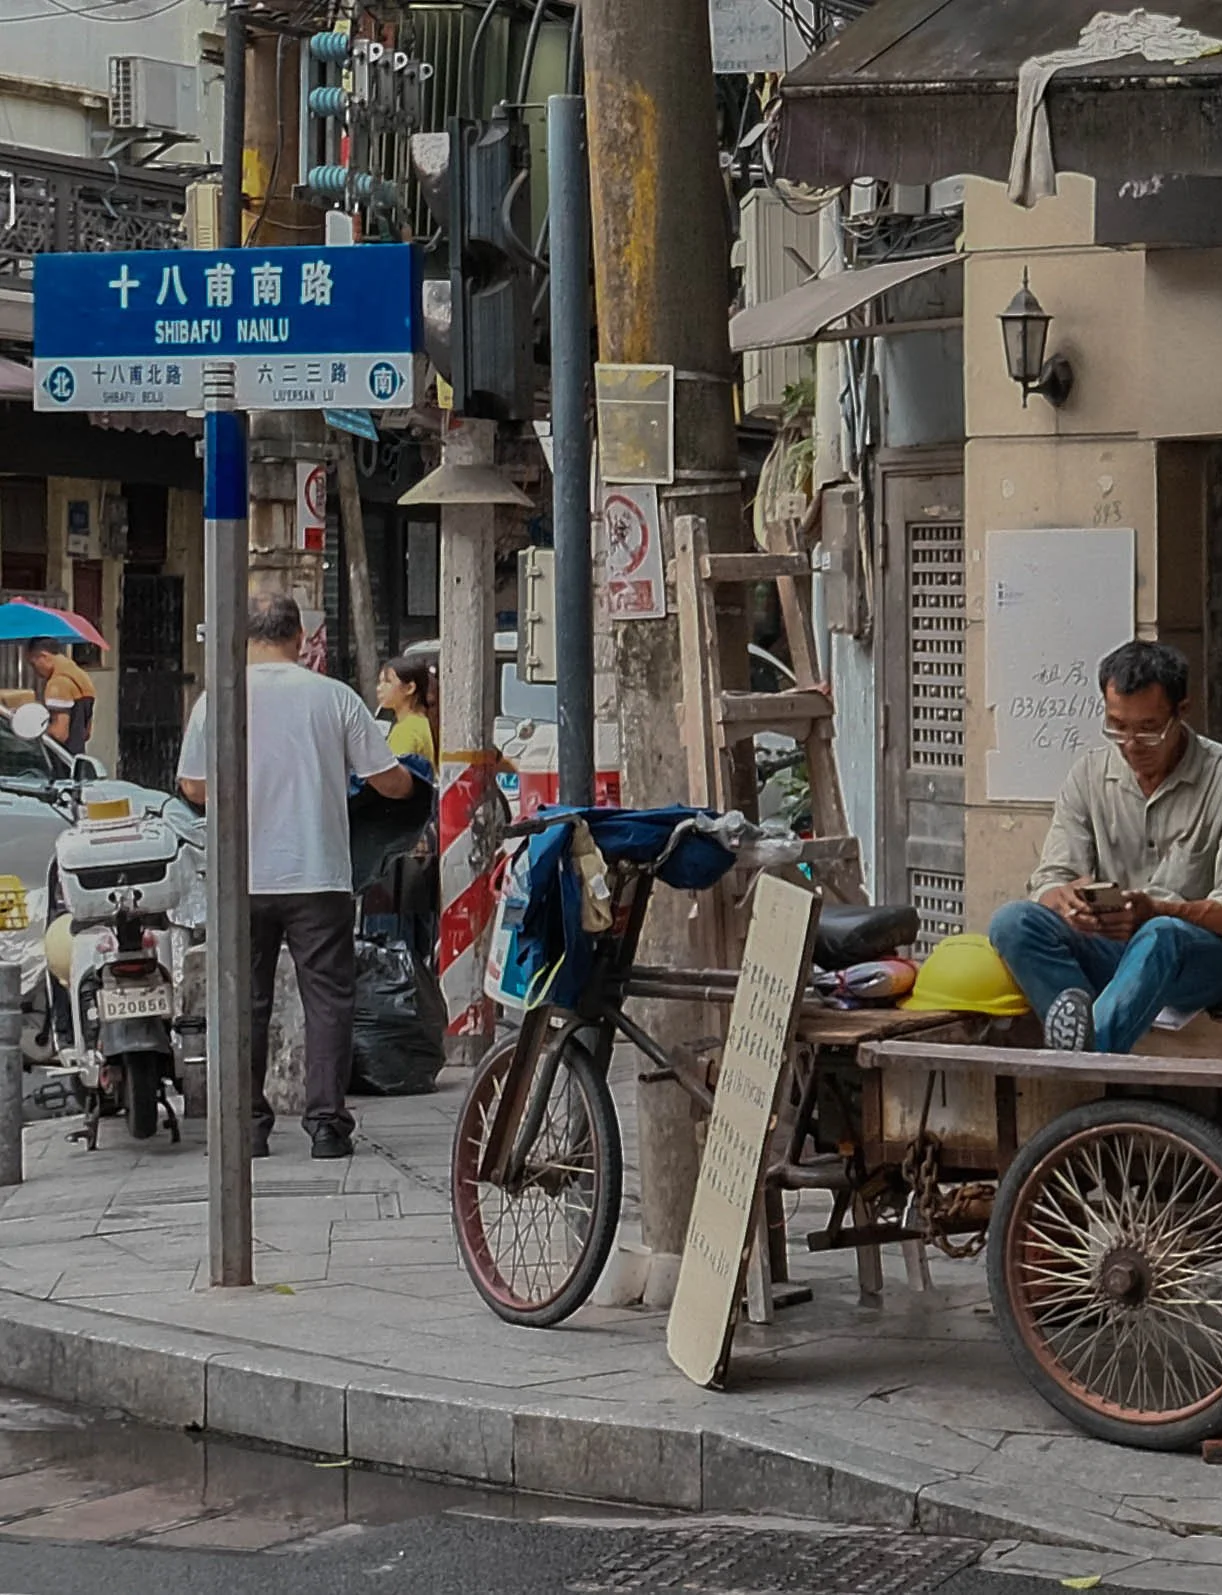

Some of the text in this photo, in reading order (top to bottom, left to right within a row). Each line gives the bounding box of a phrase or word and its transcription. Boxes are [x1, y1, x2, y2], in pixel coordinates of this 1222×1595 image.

[108, 260, 334, 309] 十八甫南路
[154, 317, 289, 345] SHIBAFU NANLU
[52, 372, 71, 396] 北
[91, 363, 182, 385] 十八甫北路
[257, 362, 347, 385] 六二三路
[373, 367, 393, 395] 南
[323, 389, 334, 402] LU
[107, 999, 167, 1016] D20856
